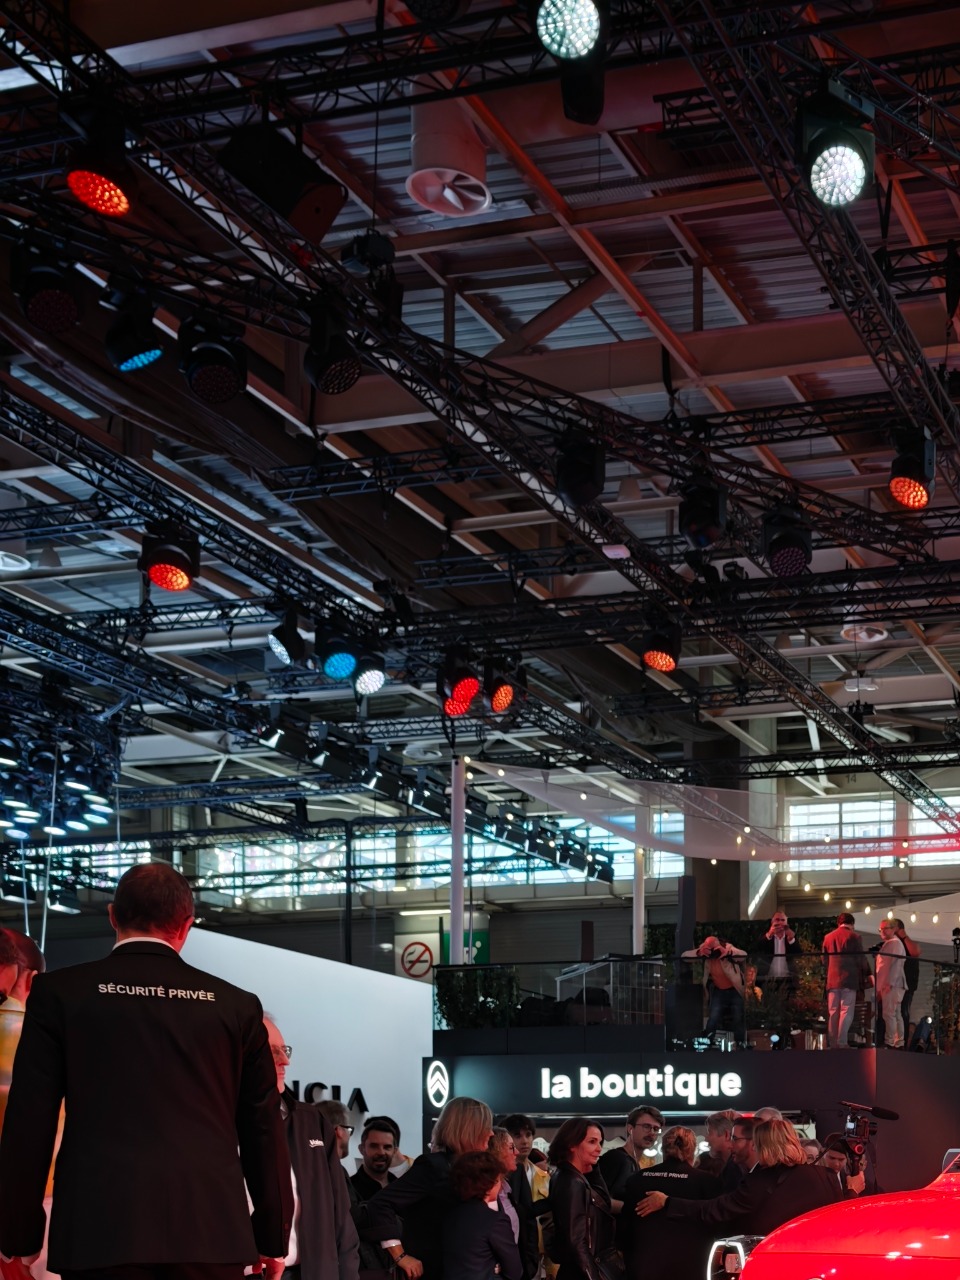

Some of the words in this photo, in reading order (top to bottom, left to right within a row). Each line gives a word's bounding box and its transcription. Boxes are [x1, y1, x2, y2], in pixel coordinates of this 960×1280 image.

[98, 982, 166, 998] SÉCURITÉ
[168, 989, 216, 1002] PRIVÉE
[541, 1067, 572, 1099] la
[580, 1064, 742, 1105] boutique
